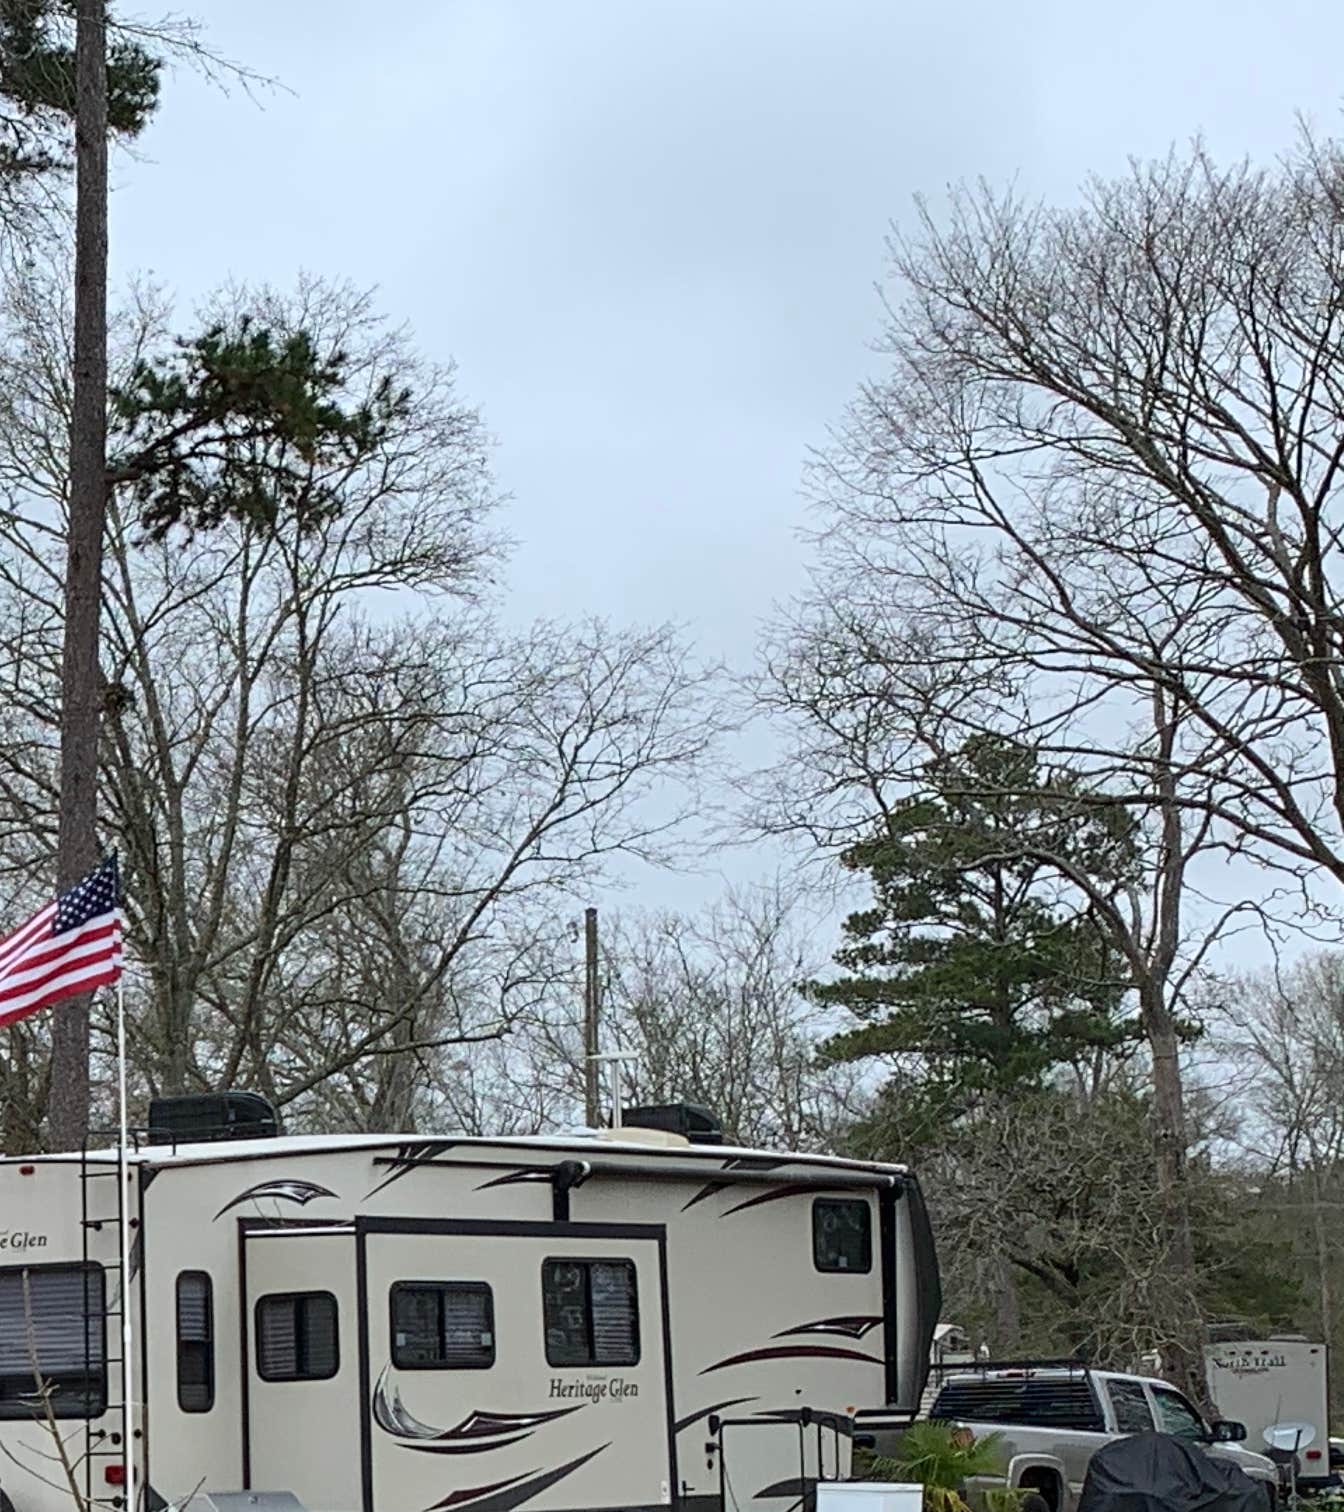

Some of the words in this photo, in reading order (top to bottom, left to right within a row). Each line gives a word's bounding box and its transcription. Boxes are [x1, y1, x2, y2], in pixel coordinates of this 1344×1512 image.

[10, 1232, 48, 1249] Glen
[548, 1378, 608, 1404] Heritage
[609, 1378, 639, 1397] Glen
